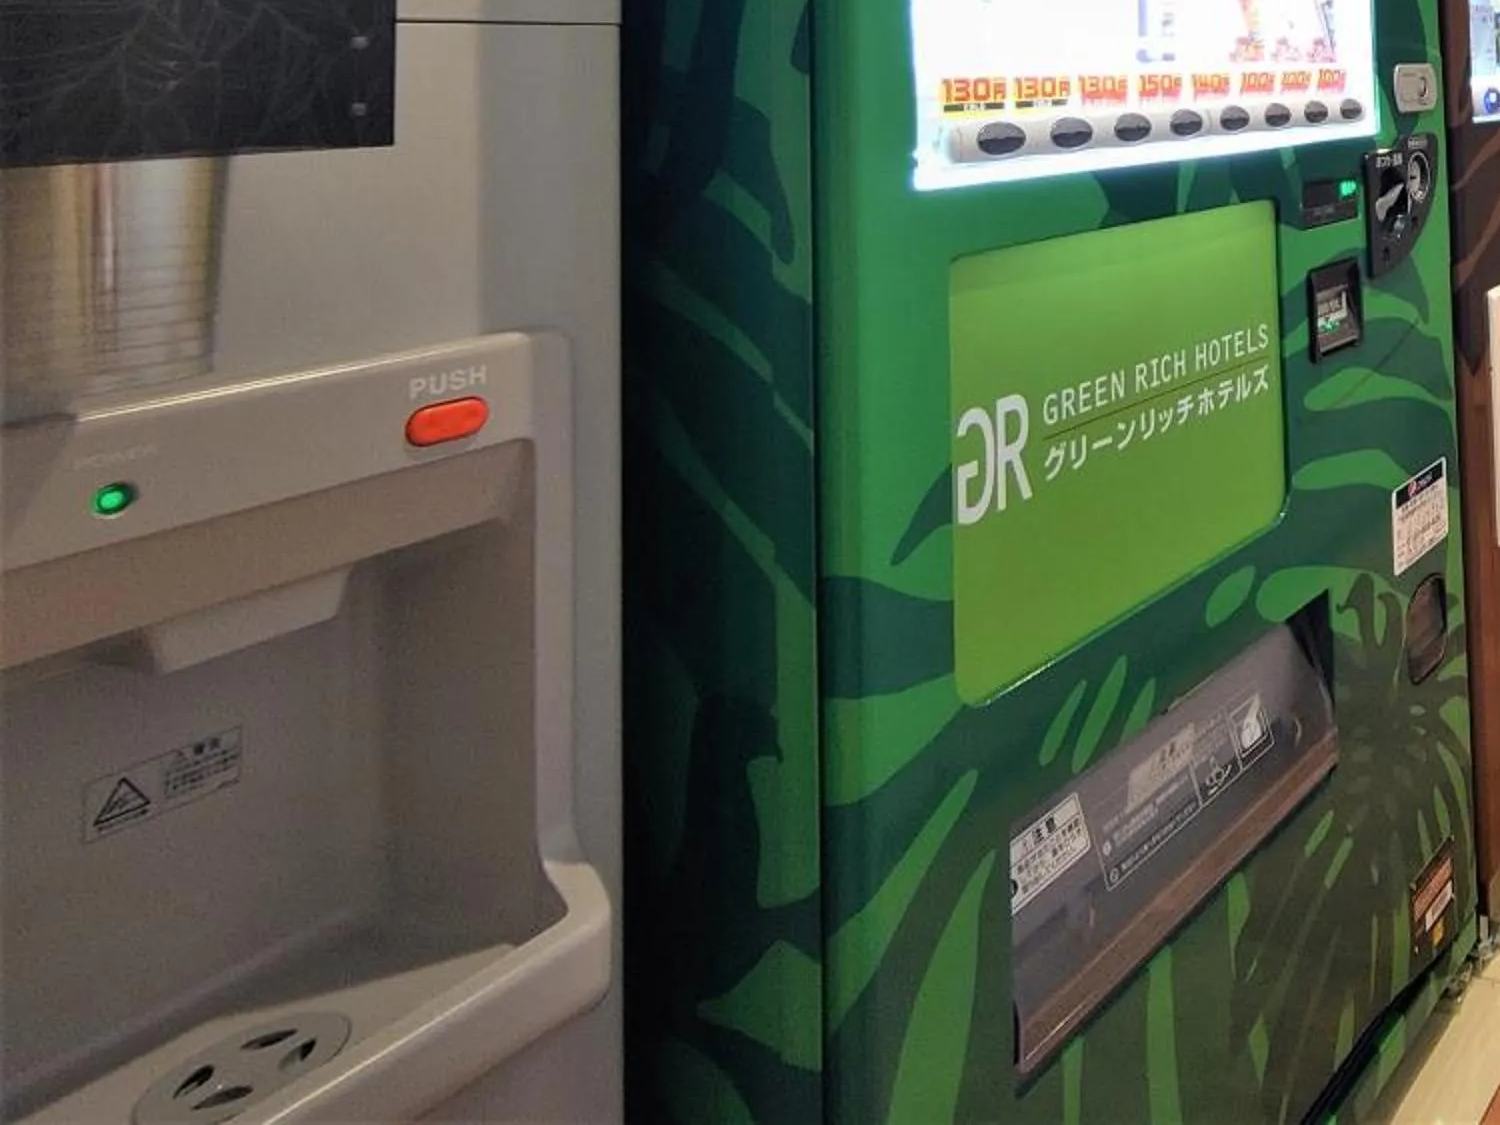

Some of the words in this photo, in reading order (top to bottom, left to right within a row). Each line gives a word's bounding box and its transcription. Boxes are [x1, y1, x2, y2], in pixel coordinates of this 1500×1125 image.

[409, 365, 488, 399] PUSH
[1043, 370, 1125, 426] GREEN
[1135, 349, 1187, 394] RICH
[1195, 324, 1269, 371] HOTELS
[1045, 365, 1269, 481] グリーンリッチホテルス
